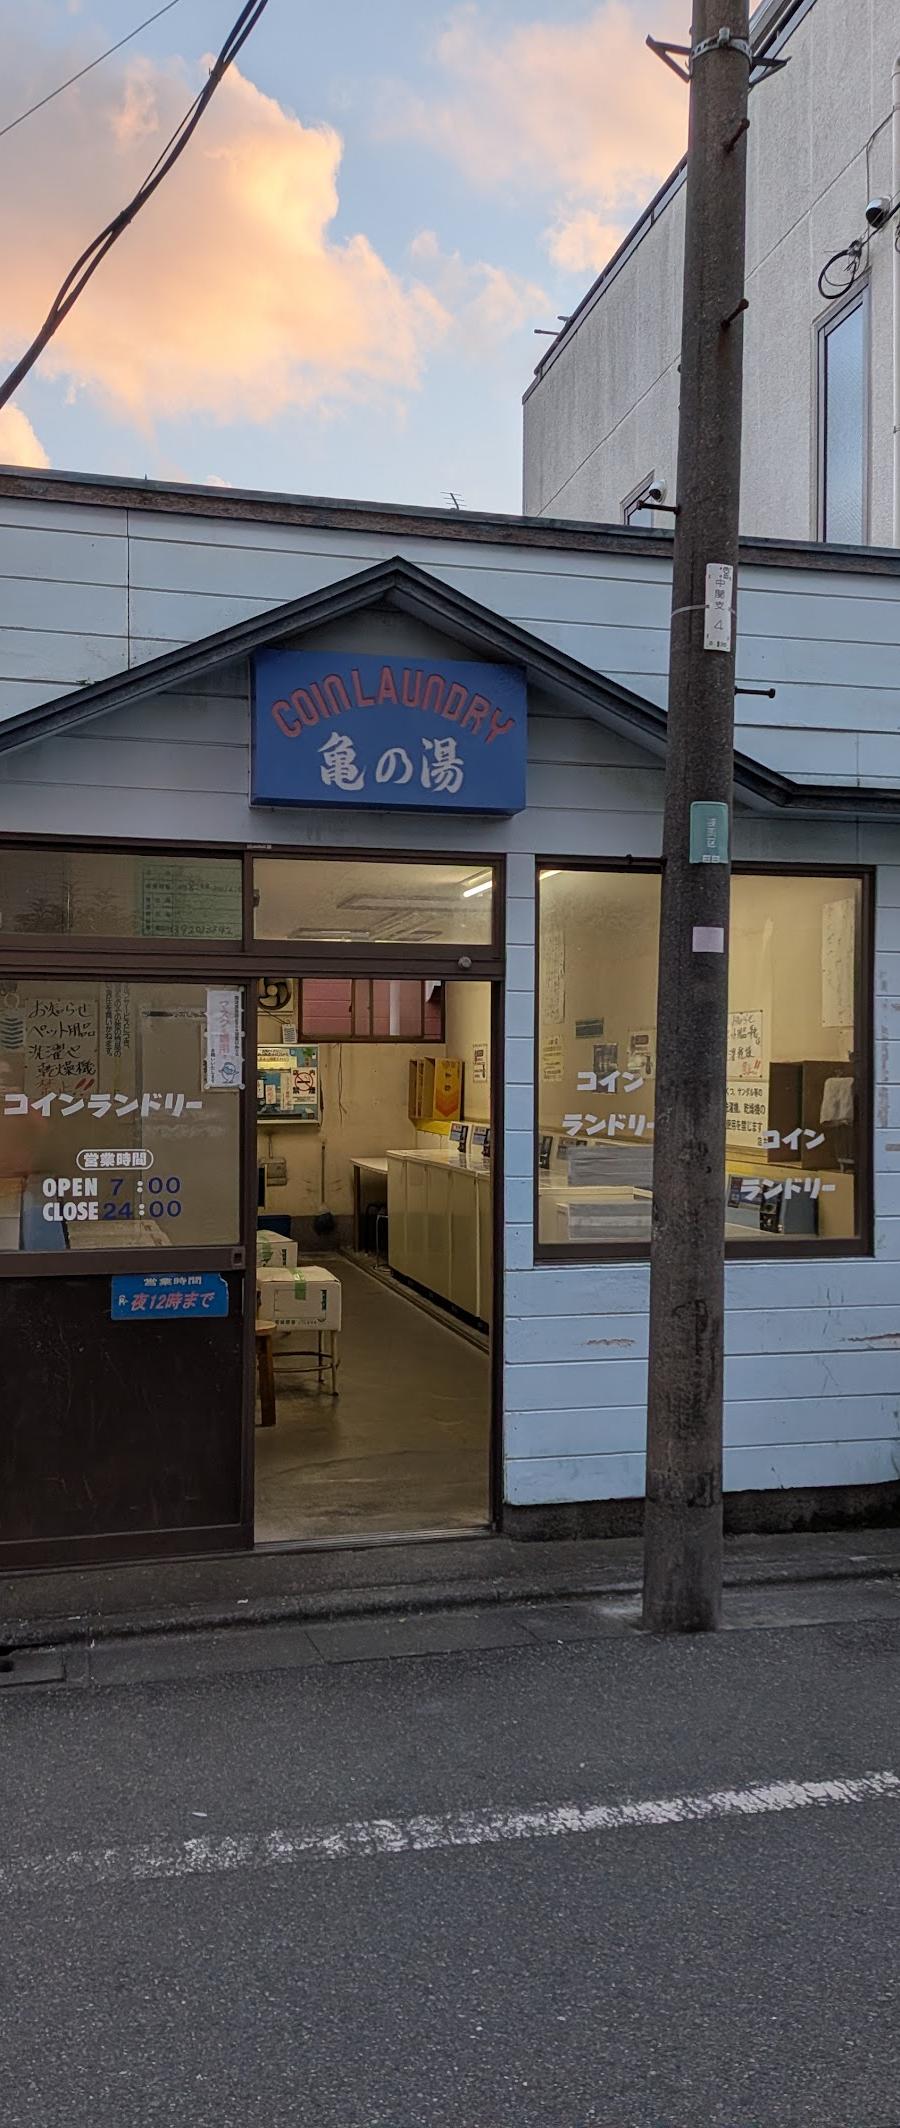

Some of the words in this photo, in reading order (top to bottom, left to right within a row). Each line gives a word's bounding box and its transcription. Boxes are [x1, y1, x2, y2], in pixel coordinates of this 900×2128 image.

[351, 665, 515, 744] LAUNDRY
[317, 731, 464, 793] 亀の湯
[29, 1000, 92, 1018] お知らせ
[33, 1020, 95, 1039] ペット用品
[576, 1071, 644, 1093] コイン
[4, 1092, 202, 1118] コインランドリー
[763, 1128, 825, 1150] コイン
[84, 1152, 147, 1167] 営業時間
[42, 1178, 98, 1197] OPEN
[741, 1178, 836, 1200] ランドリー
[42, 1202, 99, 1221] CLOSE
[143, 1276, 202, 1287] 営業時間
[131, 1292, 215, 1311] 夜12時まで
